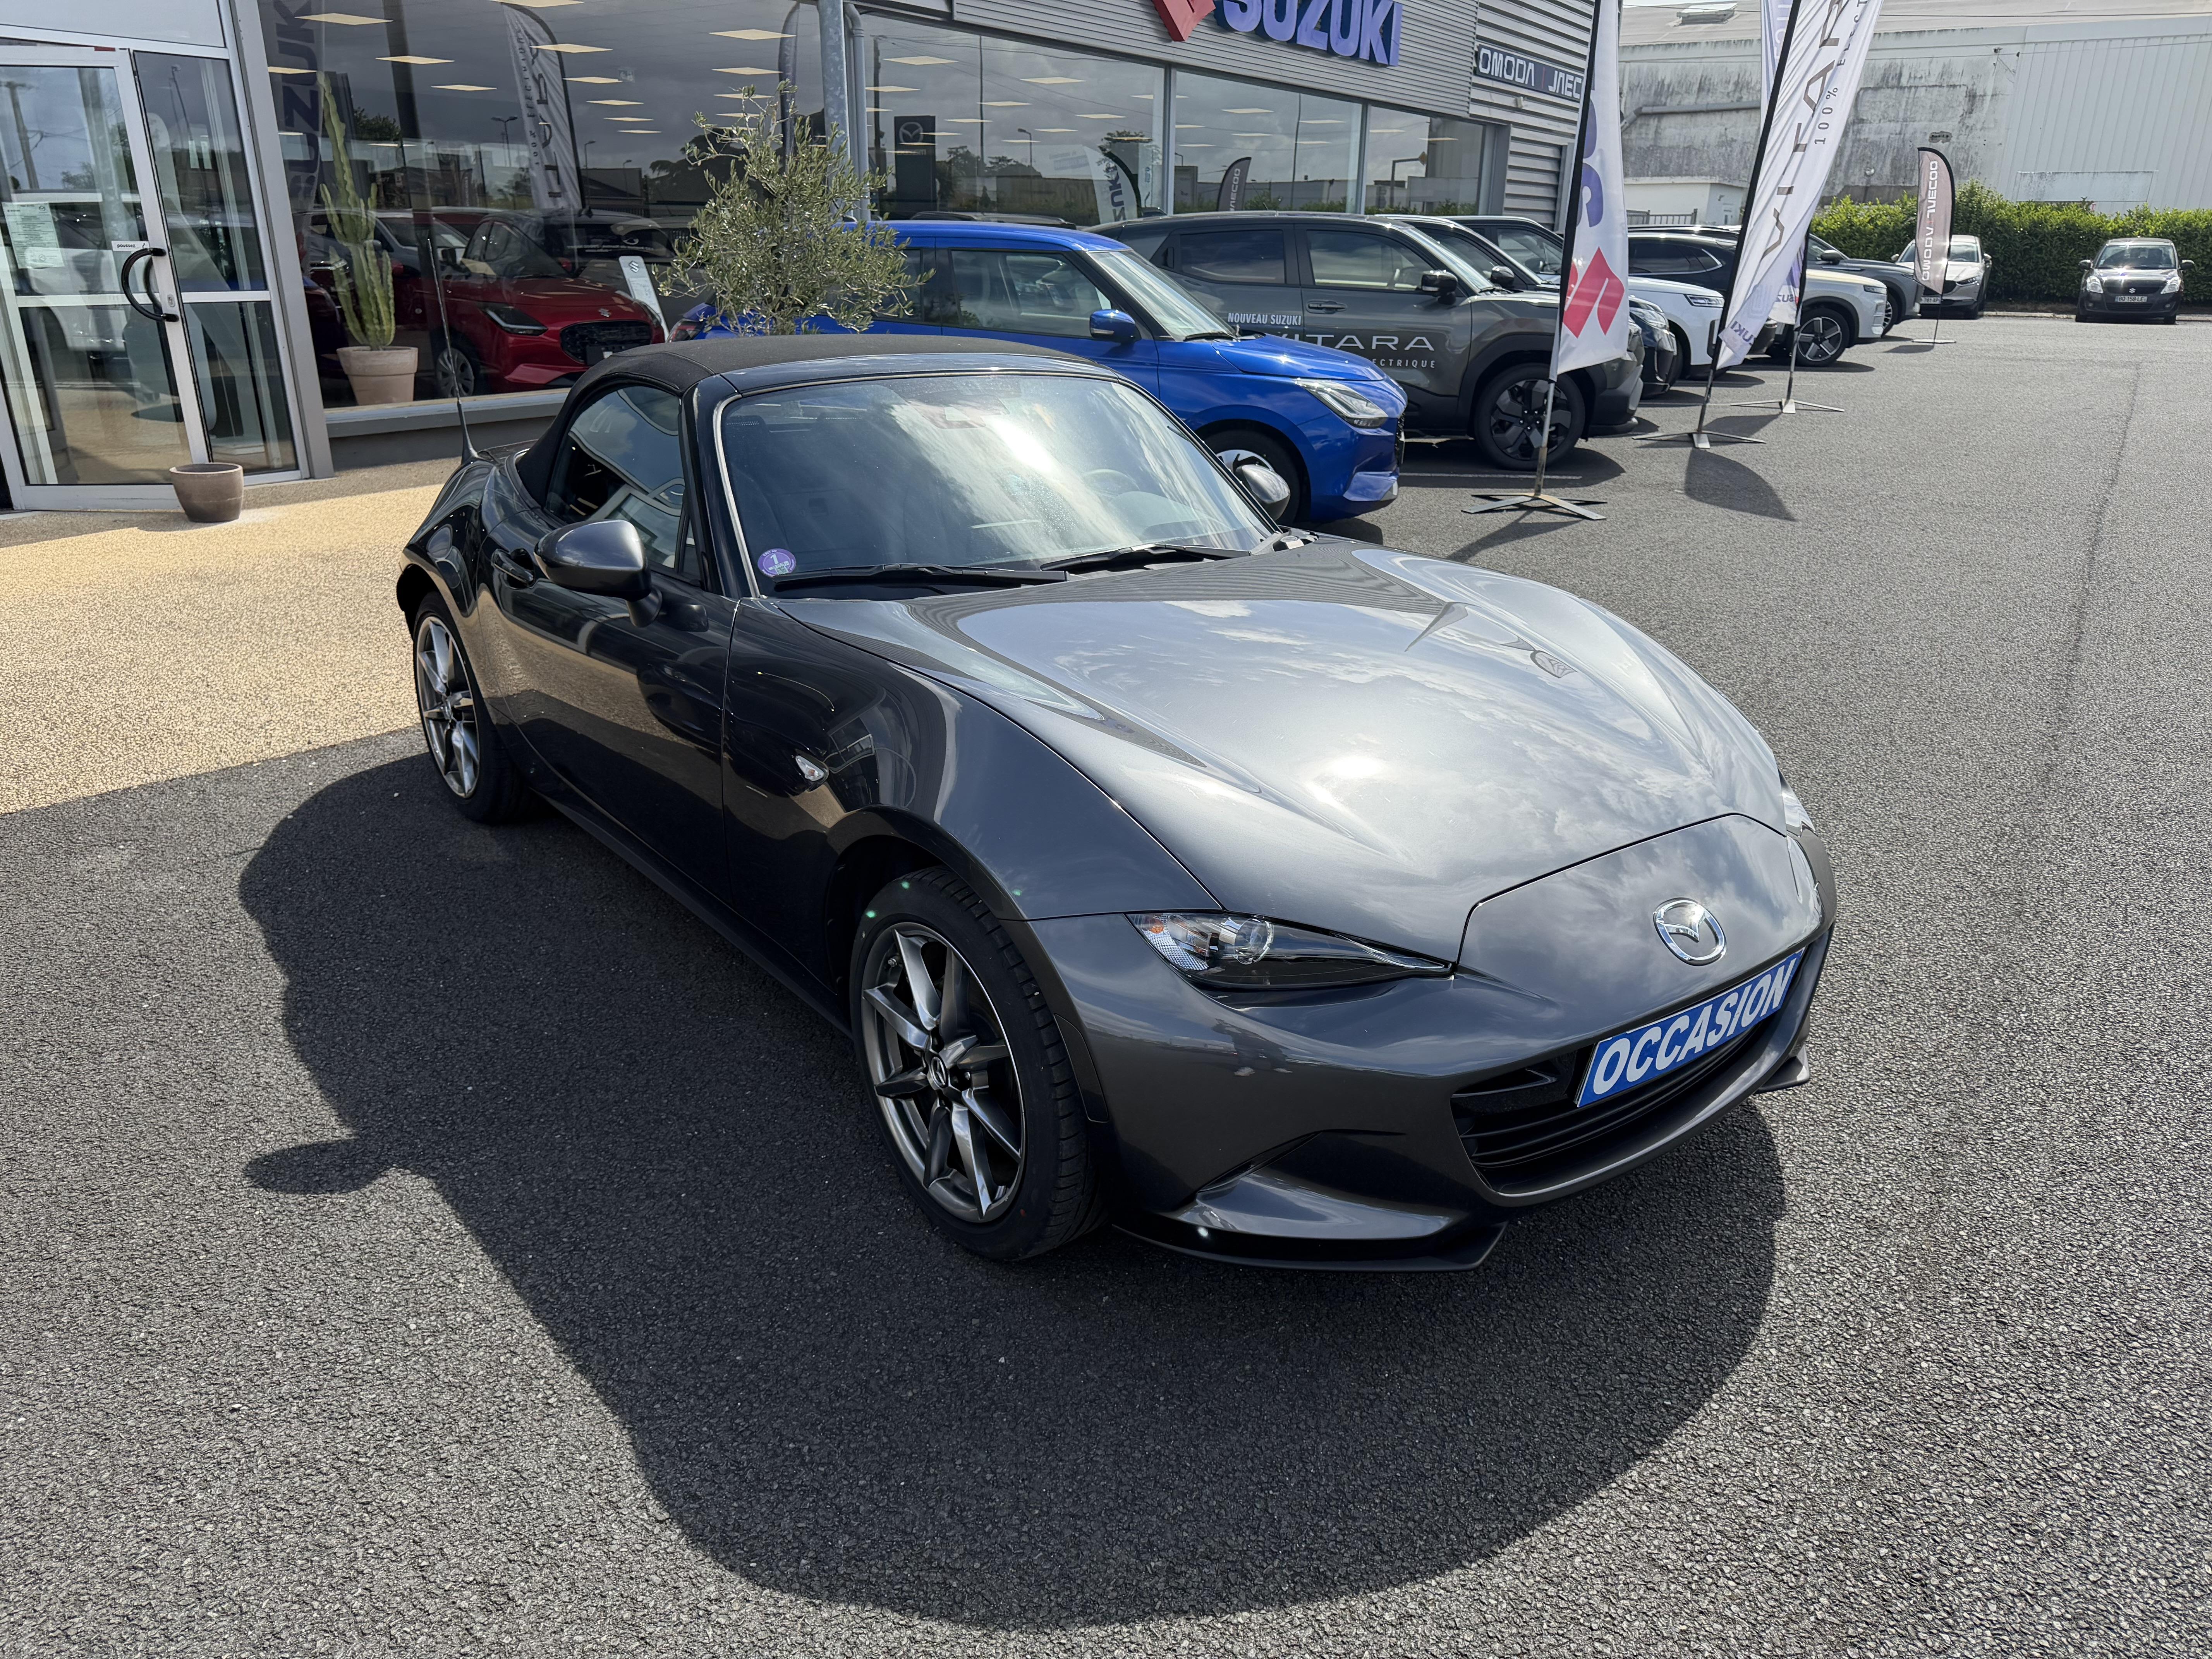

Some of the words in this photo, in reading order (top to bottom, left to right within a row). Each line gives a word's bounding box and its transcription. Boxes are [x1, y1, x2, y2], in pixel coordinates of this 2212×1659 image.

[1479, 48, 1534, 86] OMODA
[1548, 70, 1582, 99] JAEC
[1814, 88, 1838, 145] 100%
[1837, 0, 1868, 66] ELECT
[273, 0, 319, 198] SUZUK
[1229, 168, 1240, 211] AECOO
[1228, 313, 1268, 324] NOUVEAU
[1270, 314, 1302, 325] SUZUKI
[1281, 334, 1434, 351] TARA
[1372, 359, 1436, 368] ECTRIQUE
[770, 554, 779, 565] 1
[1593, 958, 1797, 1095] OCCASION
